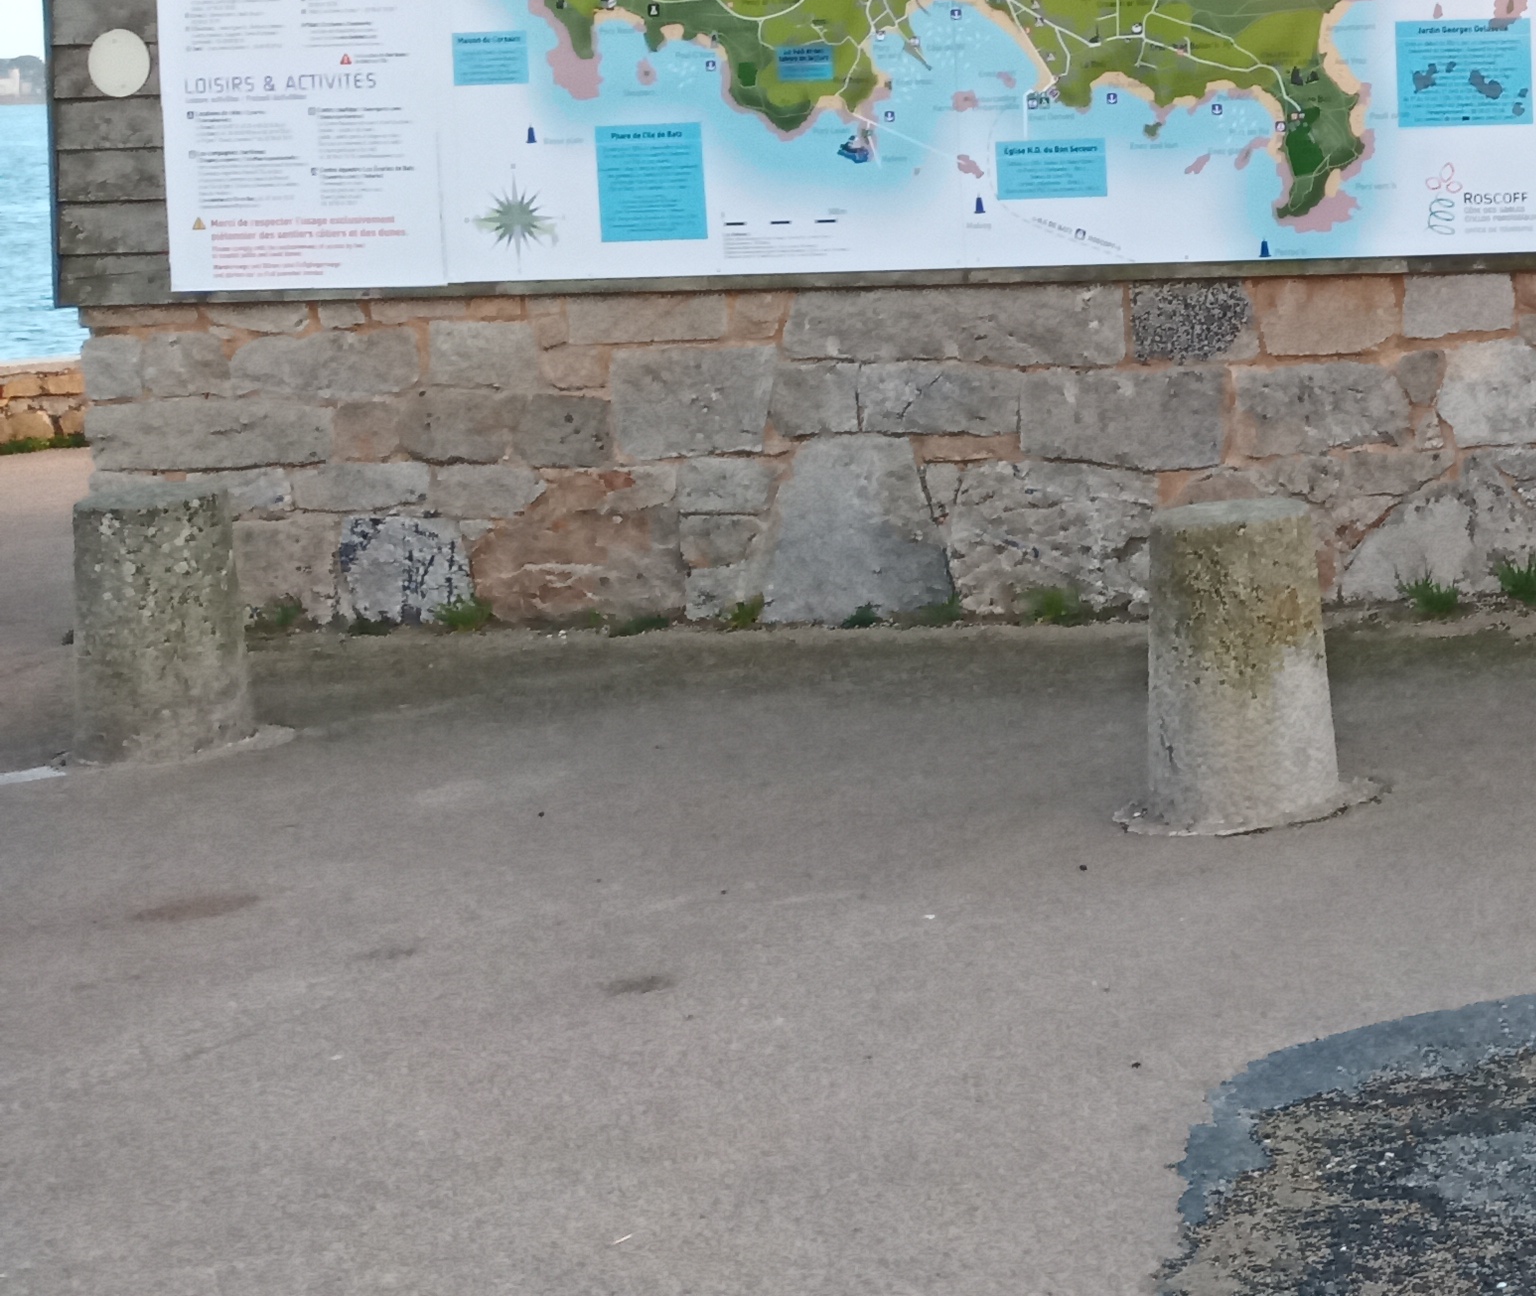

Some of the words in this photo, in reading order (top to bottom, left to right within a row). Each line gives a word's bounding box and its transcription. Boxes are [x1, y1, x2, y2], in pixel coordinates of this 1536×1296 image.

[184, 75, 256, 95] LOISIRS
[262, 75, 276, 92] &
[1463, 191, 1529, 205] ROSCOFF
